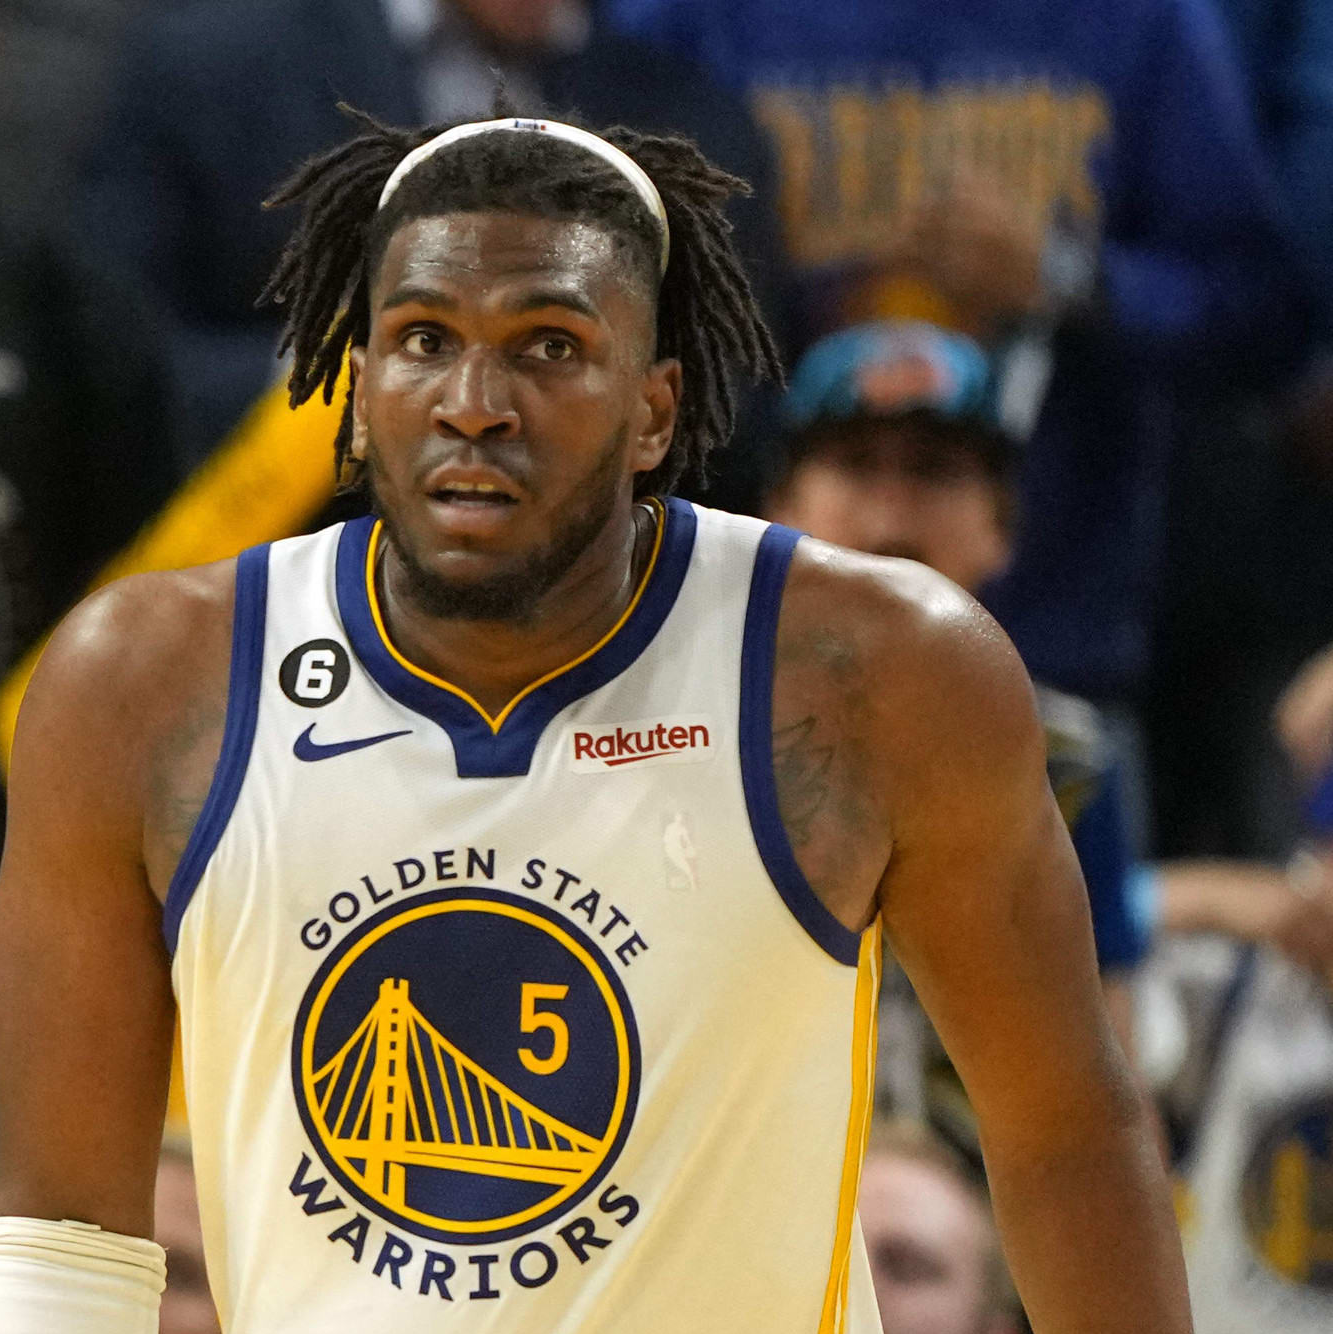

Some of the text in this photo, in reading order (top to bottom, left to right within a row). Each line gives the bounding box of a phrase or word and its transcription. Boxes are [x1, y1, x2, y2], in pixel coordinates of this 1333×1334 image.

[294, 649, 336, 700] 6
[574, 722, 710, 765] Rakuten
[300, 847, 651, 967] GOLDEN STATE
[516, 982, 570, 1076] 5
[288, 1152, 641, 1302] WARRIORS
